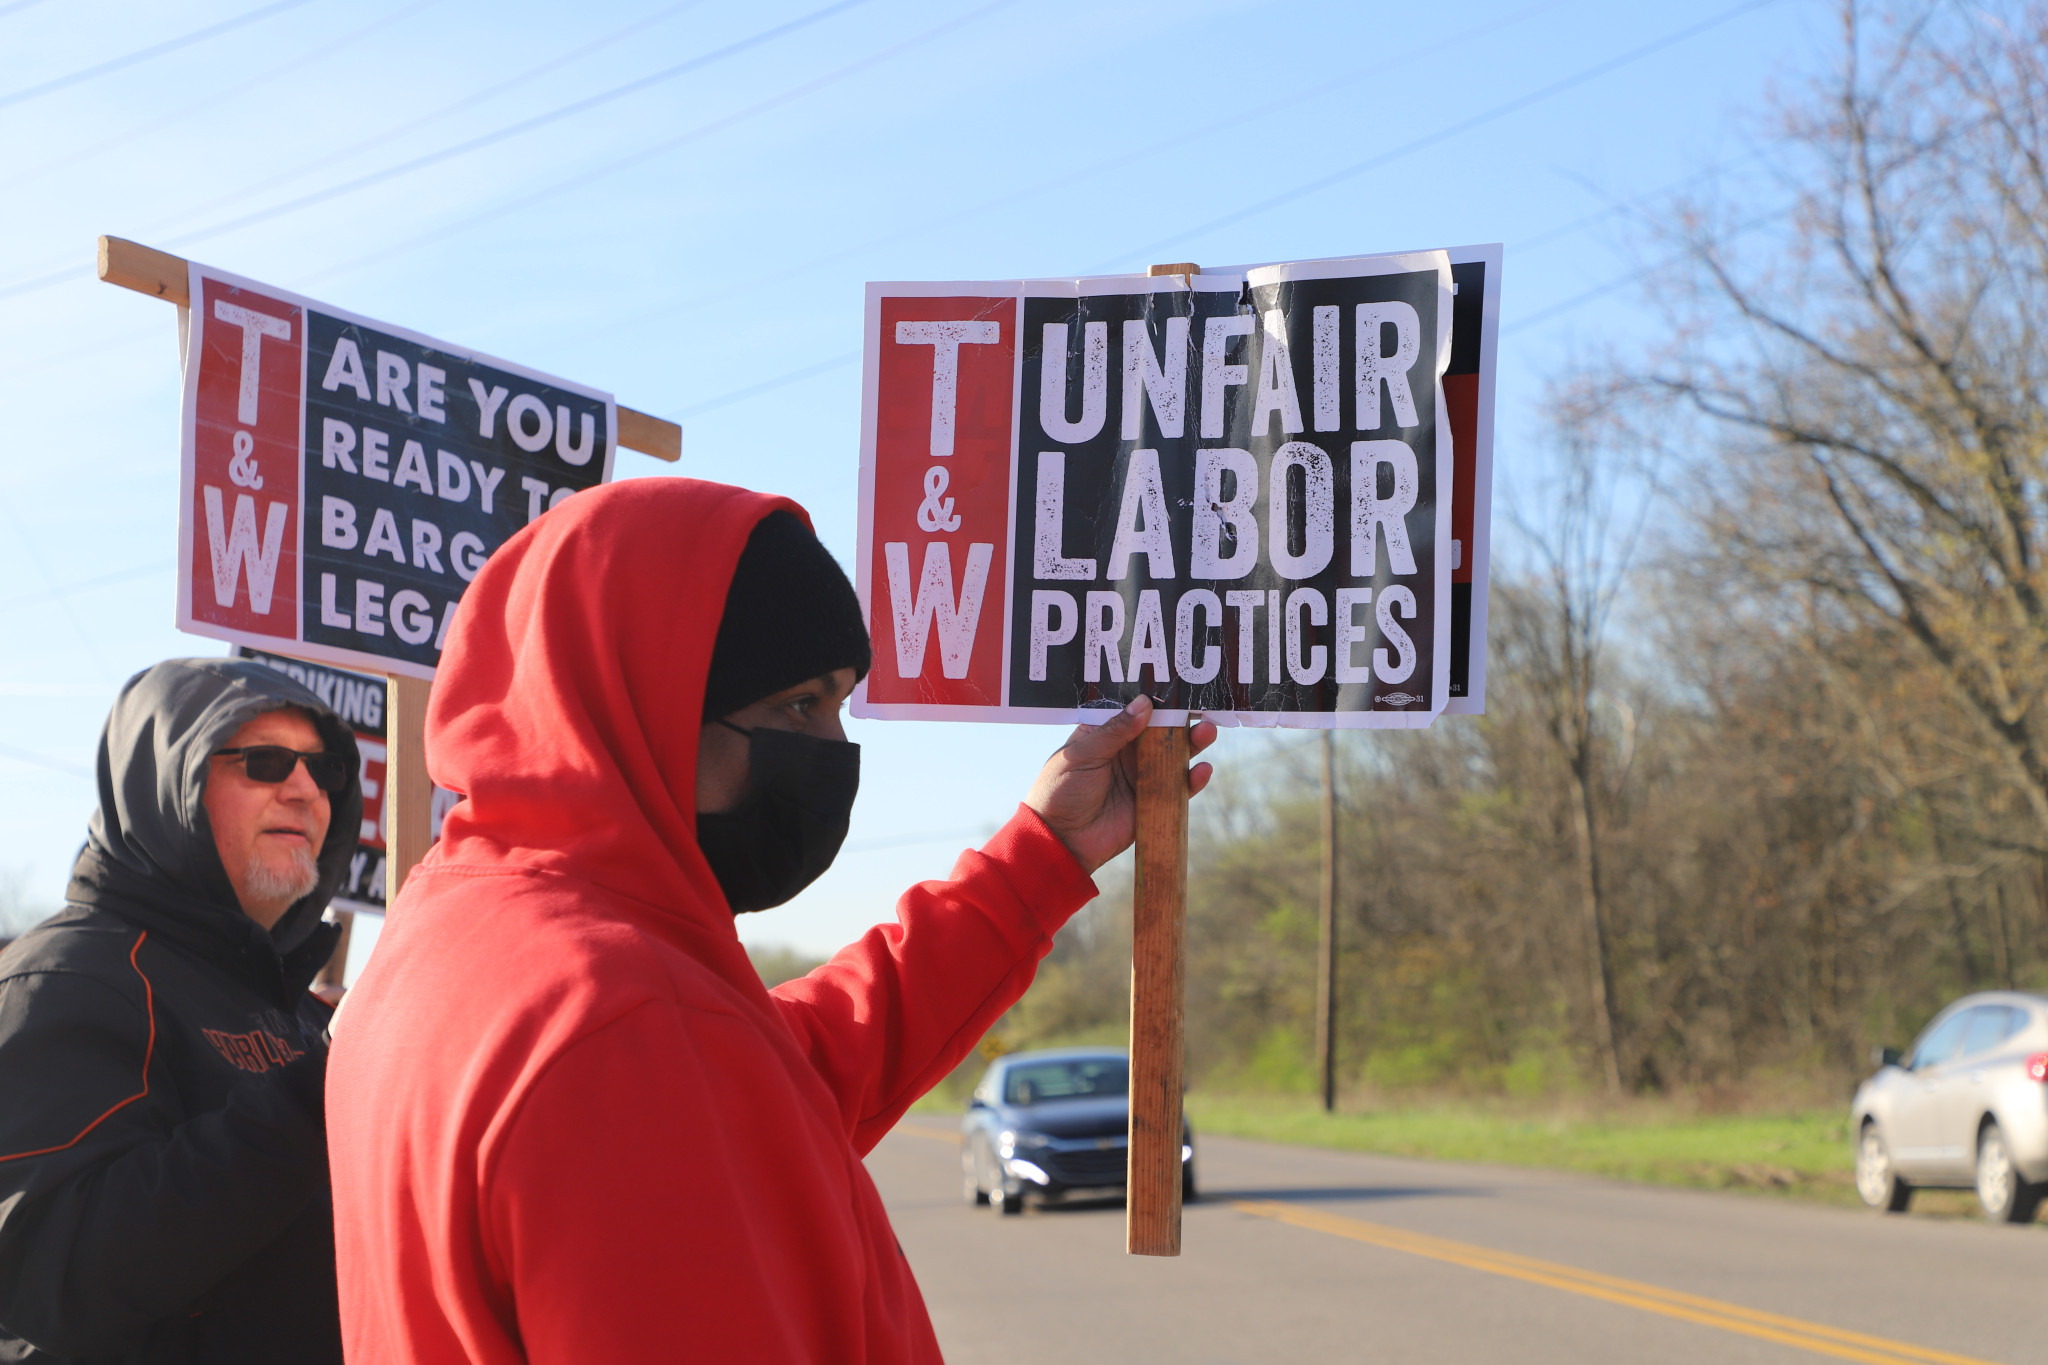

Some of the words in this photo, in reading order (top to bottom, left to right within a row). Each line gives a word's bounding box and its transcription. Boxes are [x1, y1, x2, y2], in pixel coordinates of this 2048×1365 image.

[214, 299, 291, 426] T
[321, 337, 446, 424] ARE
[468, 377, 595, 466] YOU
[896, 321, 1000, 457] T
[1040, 301, 1420, 444] UNFAIR
[228, 431, 263, 490] &
[321, 417, 505, 515] READY
[522, 475, 577, 523] T
[917, 466, 961, 533] &
[1033, 439, 1419, 580] LABOR
[203, 485, 288, 615] W
[885, 541, 994, 680] W
[253, 655, 384, 729] KING
[1029, 584, 1417, 686] PRACTICES
